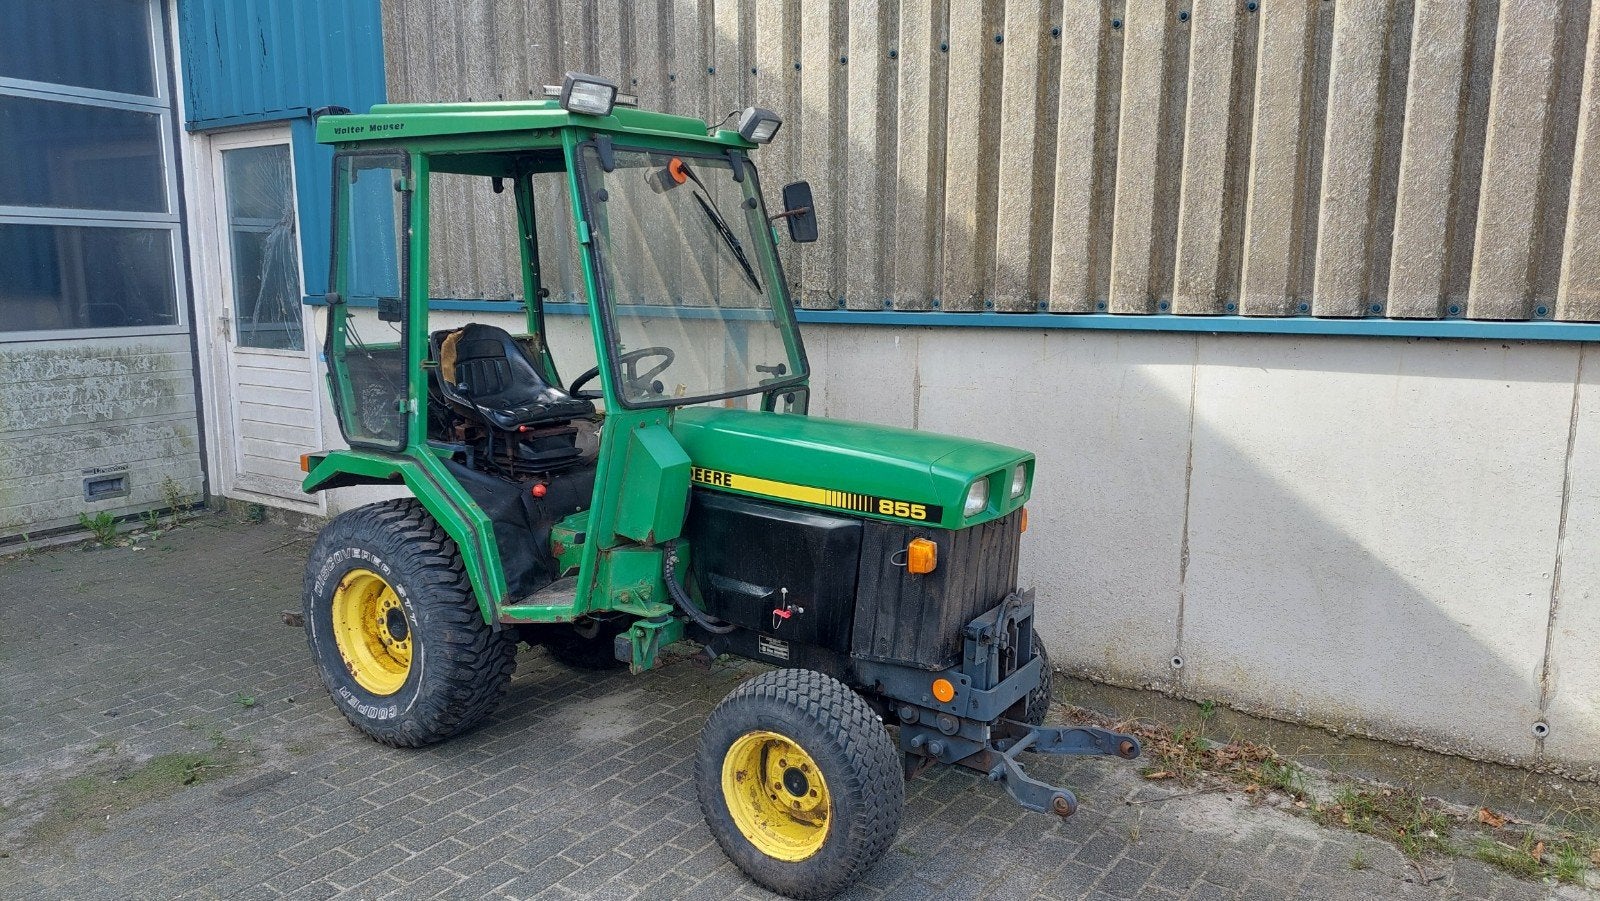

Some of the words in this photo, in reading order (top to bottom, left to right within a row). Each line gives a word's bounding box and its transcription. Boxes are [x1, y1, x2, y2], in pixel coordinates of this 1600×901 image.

[334, 126, 365, 135] Walter
[878, 498, 928, 520] 855
[314, 548, 391, 597] DISCOVERER
[396, 583, 418, 627] STT
[339, 686, 397, 720] COOPER
